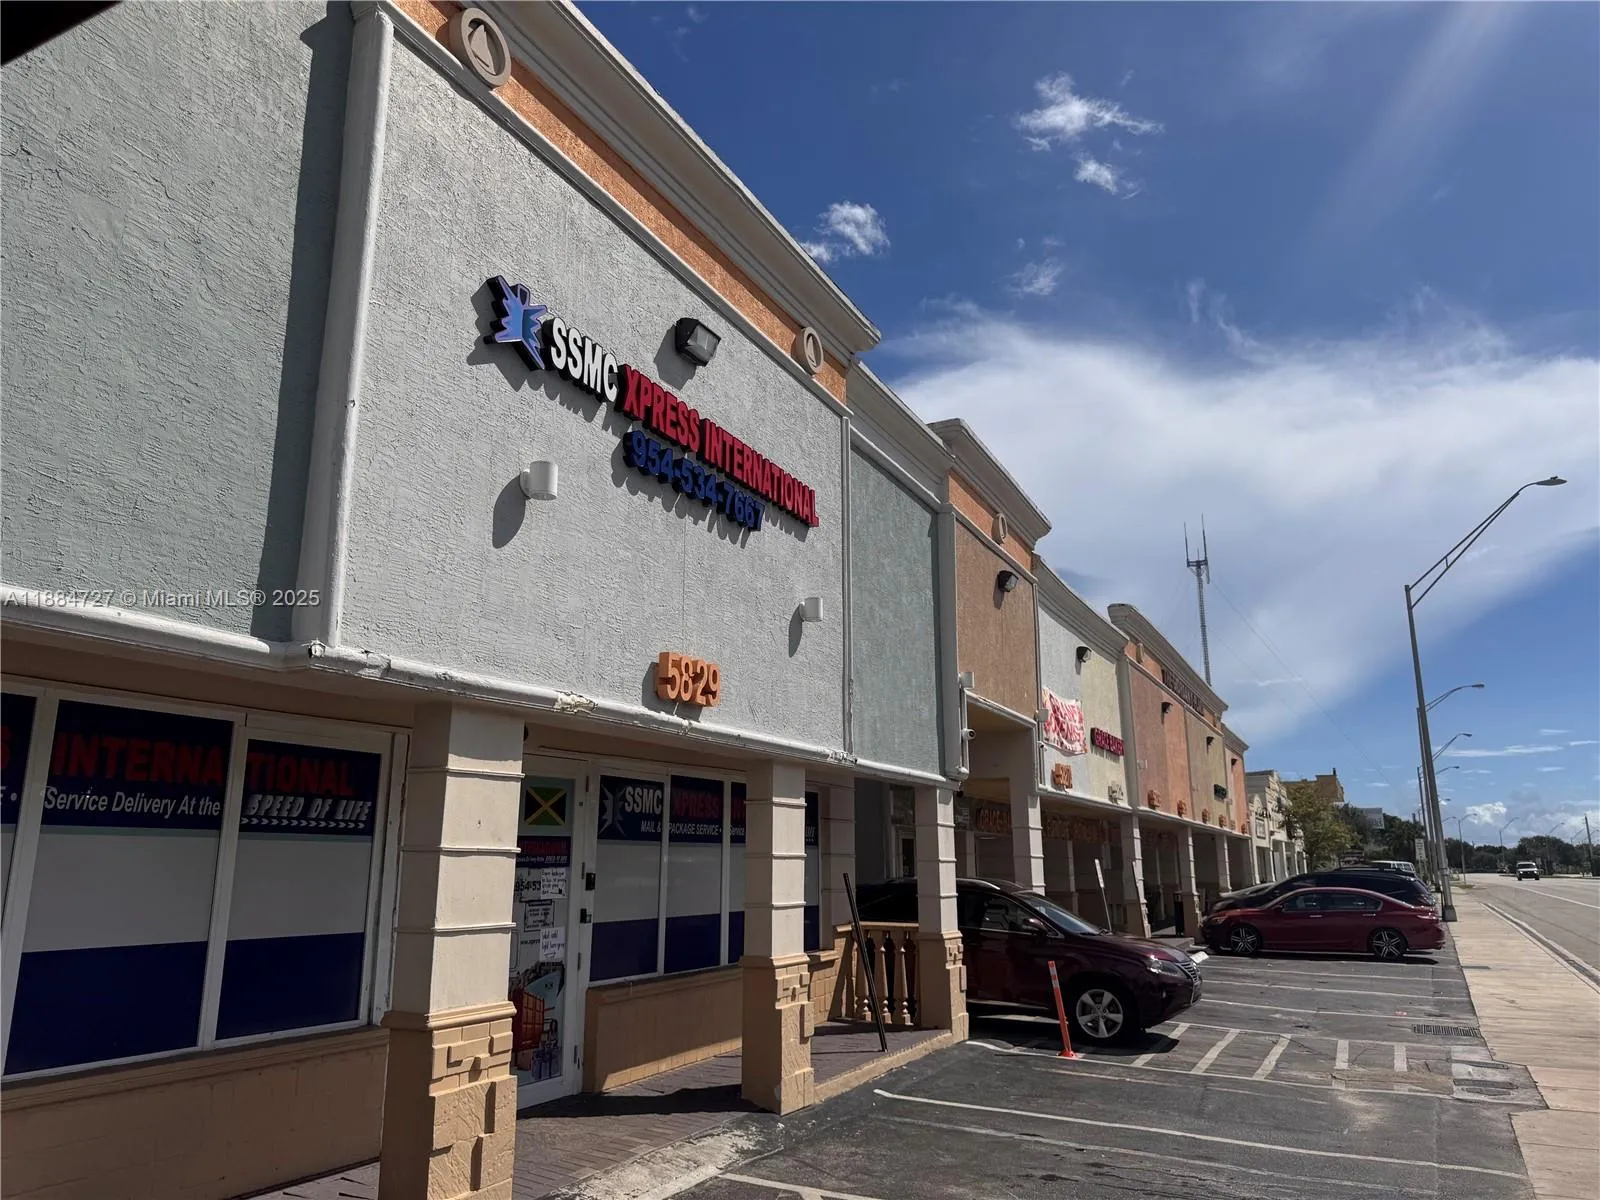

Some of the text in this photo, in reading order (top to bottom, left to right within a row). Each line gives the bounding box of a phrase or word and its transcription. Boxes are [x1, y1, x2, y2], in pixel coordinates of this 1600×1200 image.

[550, 317, 819, 527] SSMC XPRESS INTERNATIONAL
[628, 431, 765, 531] 954-534-7667
[662, 652, 720, 707] 5829
[52, 732, 354, 796] INTERNATIONAL
[44, 786, 373, 821] Service Delivery At the SPEED OF LIFE
[624, 786, 663, 815] SSMC
[640, 820, 656, 832] MAIL
[669, 822, 696, 836] PACKAGE
[696, 824, 719, 837] SERVICE
